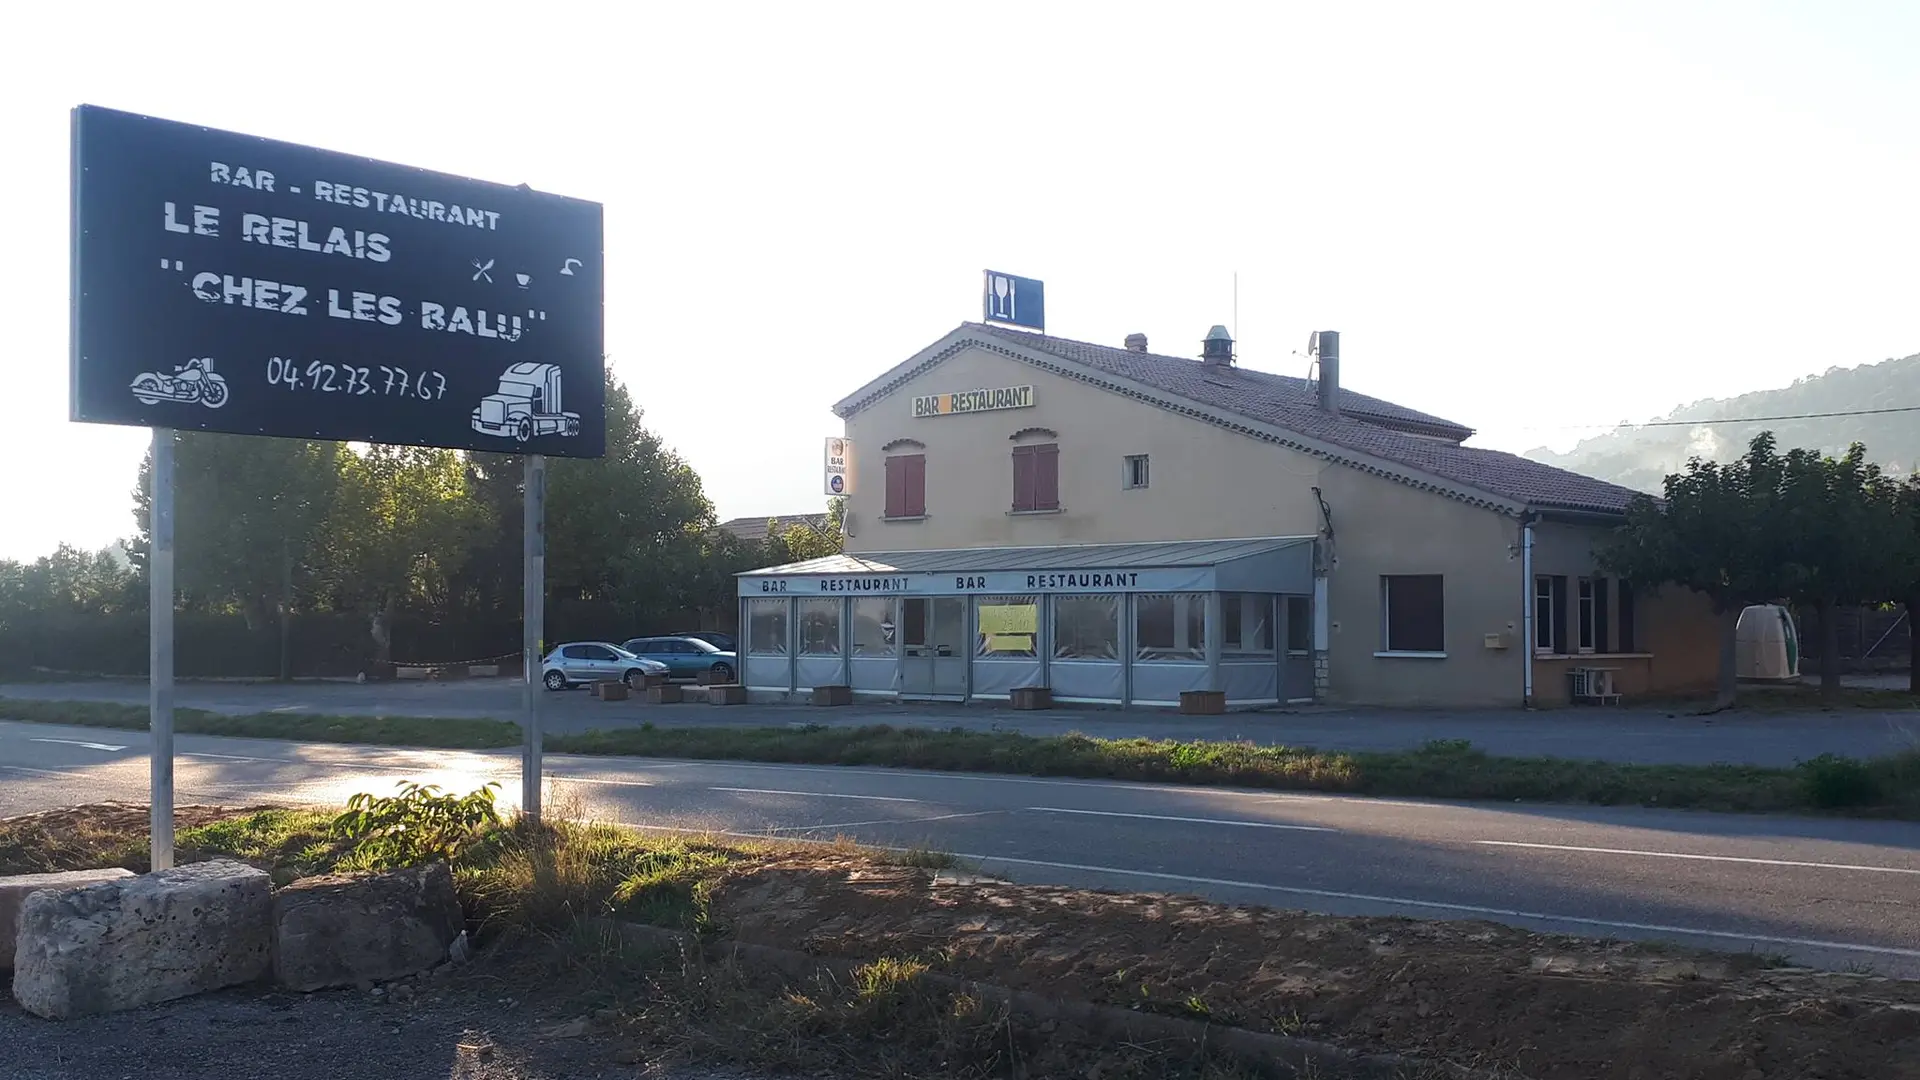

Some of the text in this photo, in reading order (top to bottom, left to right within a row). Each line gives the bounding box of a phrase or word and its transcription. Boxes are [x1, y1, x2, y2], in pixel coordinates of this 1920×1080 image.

[211, 161, 275, 193] BAR
[315, 180, 501, 231] RESTAURANT
[164, 201, 391, 262] LE RELAIS
[328, 289, 402, 325] LES
[267, 356, 447, 400] 04.92.73.77.67
[915, 386, 1030, 415] BAR RESTAURANT
[762, 573, 1138, 592] BAR RESTAURANT BAR RESTAURANT
